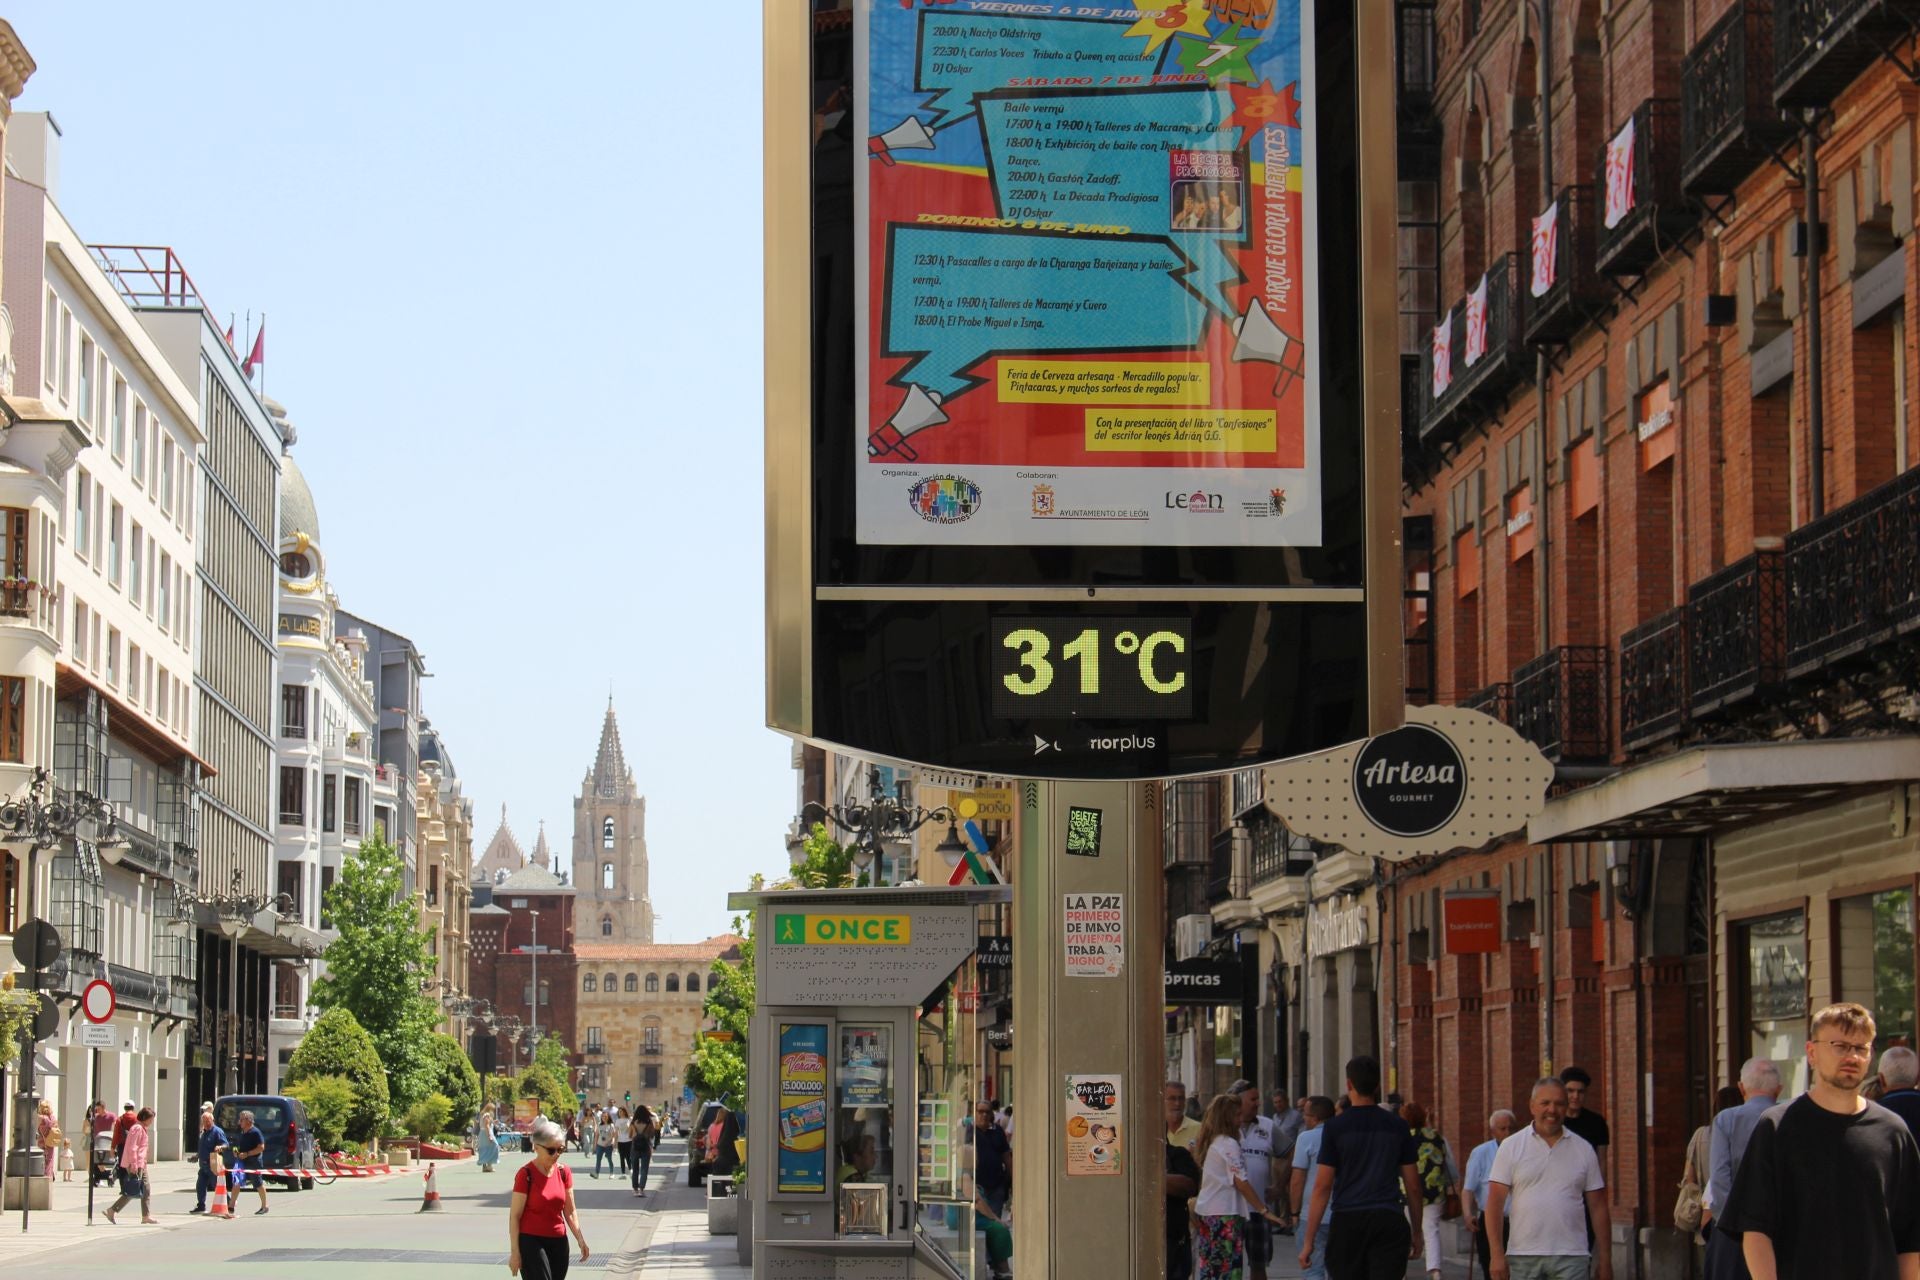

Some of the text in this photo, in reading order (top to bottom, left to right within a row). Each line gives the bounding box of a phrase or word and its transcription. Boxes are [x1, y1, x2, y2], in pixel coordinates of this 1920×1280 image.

[969, 1, 1167, 19] VIERNES 6 DE JUNIO
[1155, 3, 1188, 28] 6
[932, 27, 960, 37] 20:00
[969, 27, 998, 39] Nacho
[1000, 28, 1042, 41] Oldstring
[932, 46, 960, 57] 22:30
[969, 47, 998, 58] Carlos
[1000, 48, 1025, 58] Voces
[1033, 49, 1064, 60] Tributo
[1074, 51, 1104, 63] Queen
[1105, 55, 1116, 64] en
[1196, 45, 1239, 67] 7
[932, 64, 943, 75] DJ
[1008, 74, 1208, 87] SÁBADO 7 DE JUNIO
[1004, 102, 1031, 113] Baile
[1005, 119, 1033, 129] 17:00
[1056, 119, 1084, 131] 19:00
[1094, 121, 1131, 132] Talleres
[1134, 121, 1146, 132] de
[1005, 138, 1033, 148] 18:00
[1045, 138, 1096, 151] Exhibición
[1098, 139, 1111, 150] de
[1113, 140, 1137, 151] baile
[1140, 143, 1158, 152] con
[1008, 155, 1041, 167] Dance.
[1174, 153, 1188, 165] LA
[1176, 166, 1240, 178] PRODIGIOSA
[1008, 172, 1036, 182] 20:00
[1048, 172, 1084, 186] Gastón
[1086, 173, 1121, 186] Zadoff.
[1009, 190, 1038, 200] 22:00
[1053, 191, 1066, 201] La
[1108, 191, 1159, 204] Prodigiosa
[1009, 208, 1021, 220] DJ
[917, 213, 1131, 235] DOMINGO 8 DE JUNIO
[1265, 203, 1290, 255] GLORIA
[914, 254, 938, 266] 12:30
[947, 255, 992, 267] Pasacalles
[1002, 259, 1025, 269] cargo
[1027, 257, 1038, 268] de
[1040, 257, 1048, 268] la
[1050, 257, 1091, 270] Charanga
[1141, 261, 1147, 271] y
[1149, 259, 1174, 270] bailes
[1265, 257, 1292, 312] PARQUE
[914, 296, 938, 307] 17:00
[957, 297, 981, 308] 19:00
[990, 298, 1020, 309] Talleres
[1023, 299, 1033, 309] de
[1035, 298, 1073, 312] Macramé
[1076, 302, 1082, 312] y
[1083, 299, 1107, 311] Cuero
[914, 315, 938, 326] 18:00
[947, 316, 956, 327] El
[958, 316, 982, 327] Probe
[984, 316, 1012, 329] Miguel
[1021, 317, 1045, 330] Isma.
[1007, 368, 1028, 379] Feria
[1030, 369, 1041, 380] de
[1042, 369, 1075, 381] Cerveza
[1077, 371, 1114, 384] artesana
[1123, 370, 1165, 382] Mercadillo
[1059, 384, 1065, 395] y
[1067, 382, 1099, 394] muchos
[1102, 383, 1131, 394] sorteos
[1133, 383, 1143, 394] de
[1146, 383, 1180, 396] regalos!
[1096, 416, 1113, 430] Con
[1114, 417, 1123, 428] la
[1125, 417, 1177, 430] presentación
[1179, 417, 1192, 429] del
[1194, 417, 1213, 429] libro
[1094, 429, 1222, 443] del escritor leonés Adrián G.G.
[881, 469, 920, 479] Organiza:
[1016, 471, 1059, 480] Colaboran:
[946, 473, 956, 481] de
[957, 475, 983, 495] Vecinos
[922, 512, 971, 525] San Mamés
[1059, 508, 1149, 518] AYUNTAMIENTO DE LEÓN
[1363, 758, 1455, 788] Artesa
[1389, 794, 1434, 802] GOURMET
[1071, 810, 1098, 822] DELETE
[1066, 896, 1121, 910] LA PAZ
[1066, 911, 1121, 921] PRIMERO
[816, 919, 900, 940] ONCE
[1067, 922, 1121, 933] DE MAYO
[1067, 933, 1121, 944] VIVIENDA
[989, 939, 999, 952] A
[1068, 945, 1122, 955] TRABA
[977, 953, 1012, 966] PELUQU
[1067, 956, 1105, 966] DIGNO
[988, 1030, 1008, 1040] Bers
[784, 1053, 823, 1077] Verano
[1077, 1085, 1093, 1095] BAR
